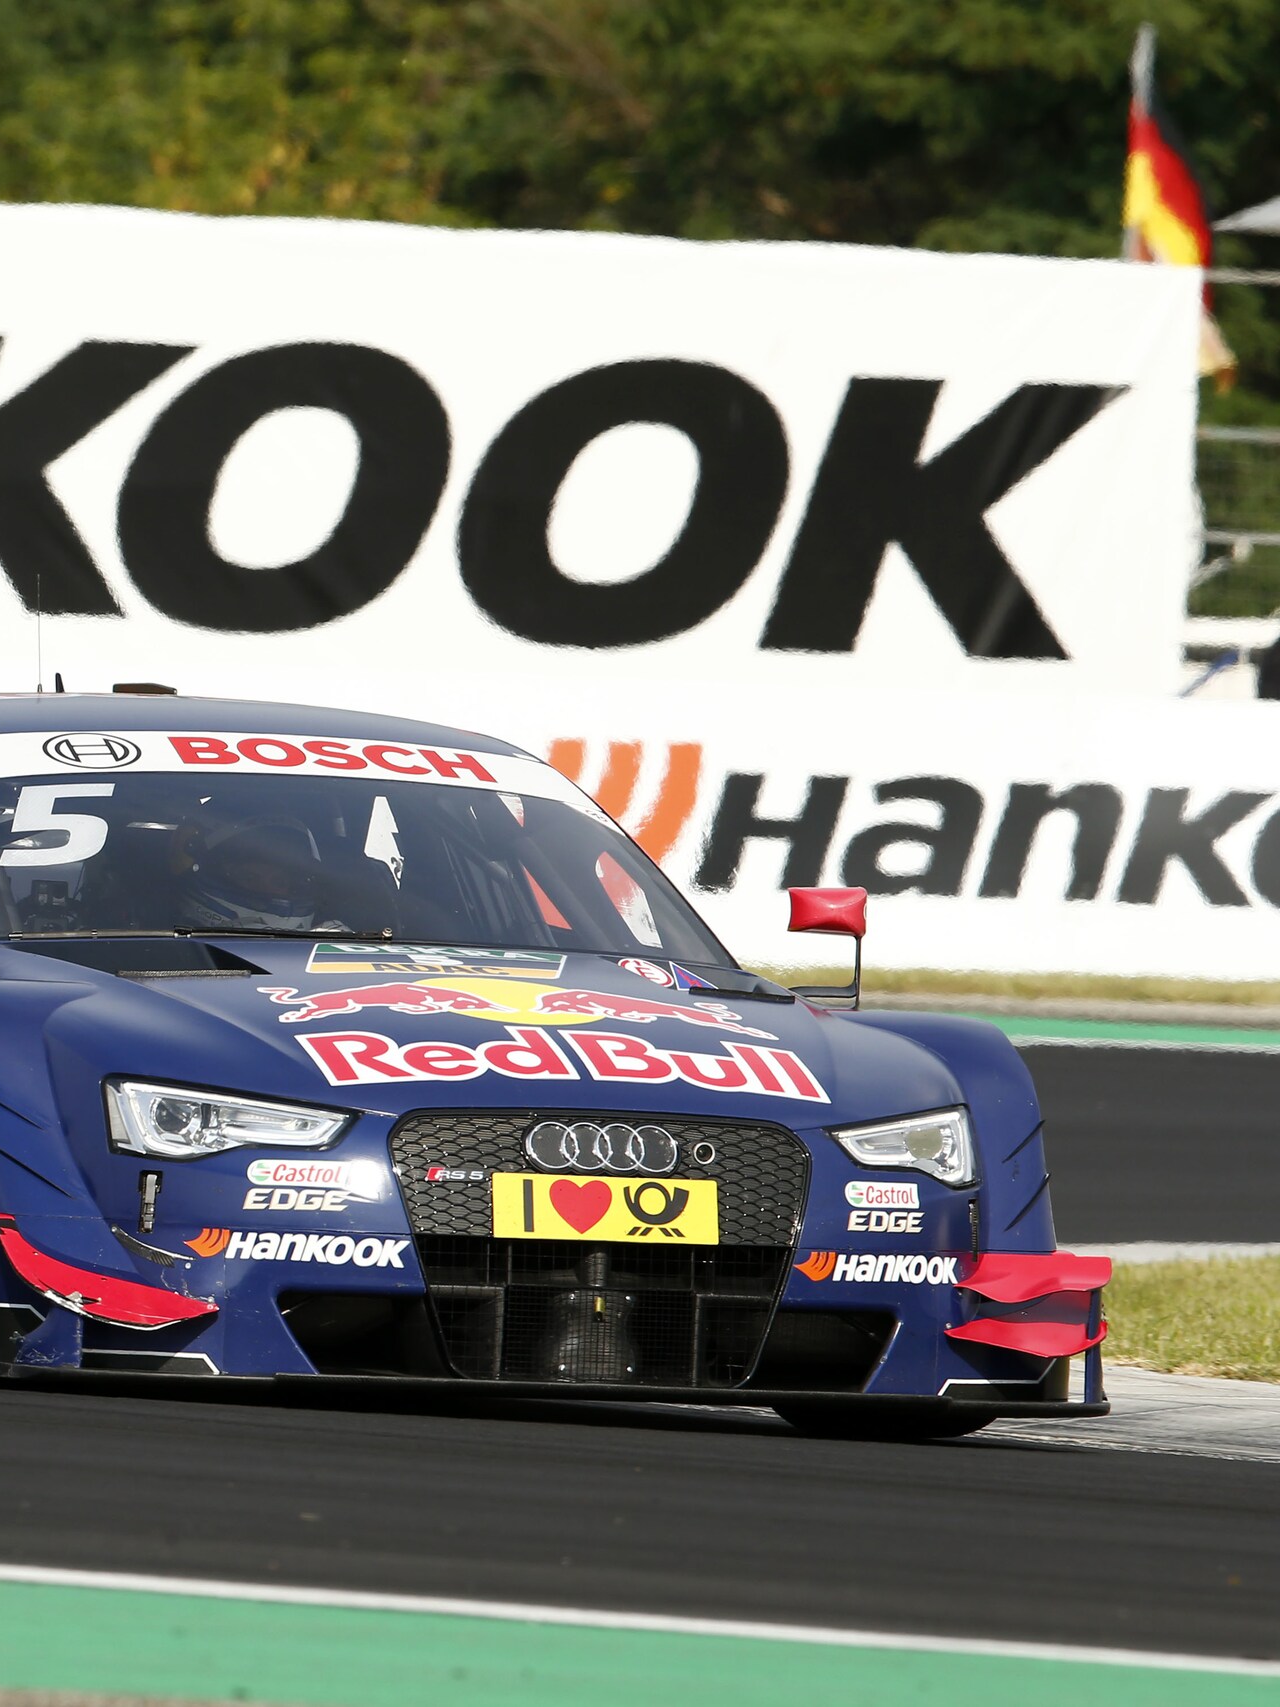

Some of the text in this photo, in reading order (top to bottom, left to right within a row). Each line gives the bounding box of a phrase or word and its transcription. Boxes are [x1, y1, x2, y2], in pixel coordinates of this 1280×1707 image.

[167, 735, 498, 783] BOSCH
[690, 771, 1280, 908] HanK
[371, 963, 510, 976] ADAC
[300, 1026, 827, 1101] Red Bull
[272, 1163, 342, 1184] Castrol
[242, 1187, 355, 1212] EDGE
[865, 1185, 916, 1205] Castrol
[846, 1209, 926, 1233] EDGE
[224, 1230, 411, 1269] HanKOOK
[832, 1253, 959, 1285] HanKOOK
